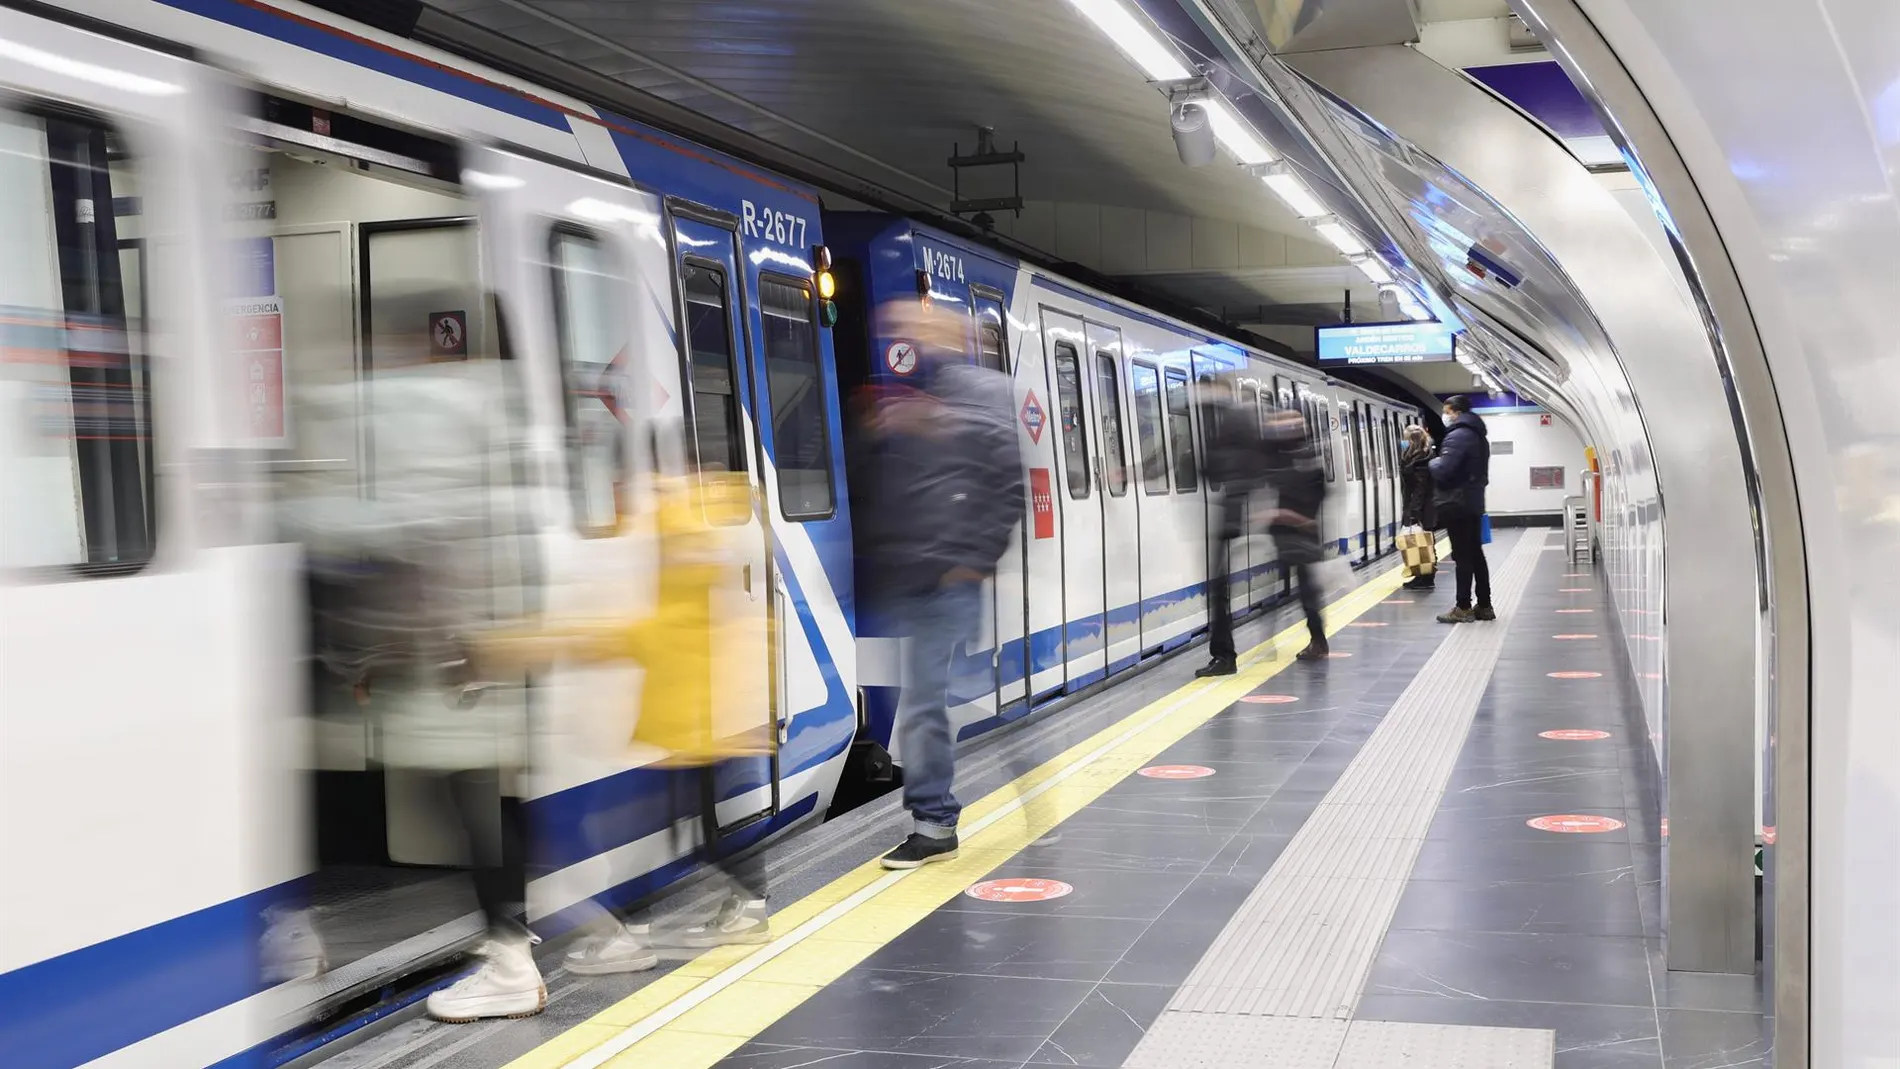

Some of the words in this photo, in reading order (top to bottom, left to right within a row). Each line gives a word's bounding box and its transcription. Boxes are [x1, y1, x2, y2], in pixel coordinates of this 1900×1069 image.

[742, 199, 806, 249] R-2677
[922, 245, 965, 284] M-2674
[1344, 344, 1426, 355] VALDECARROS
[1347, 355, 1376, 364] PRÓXIMO
